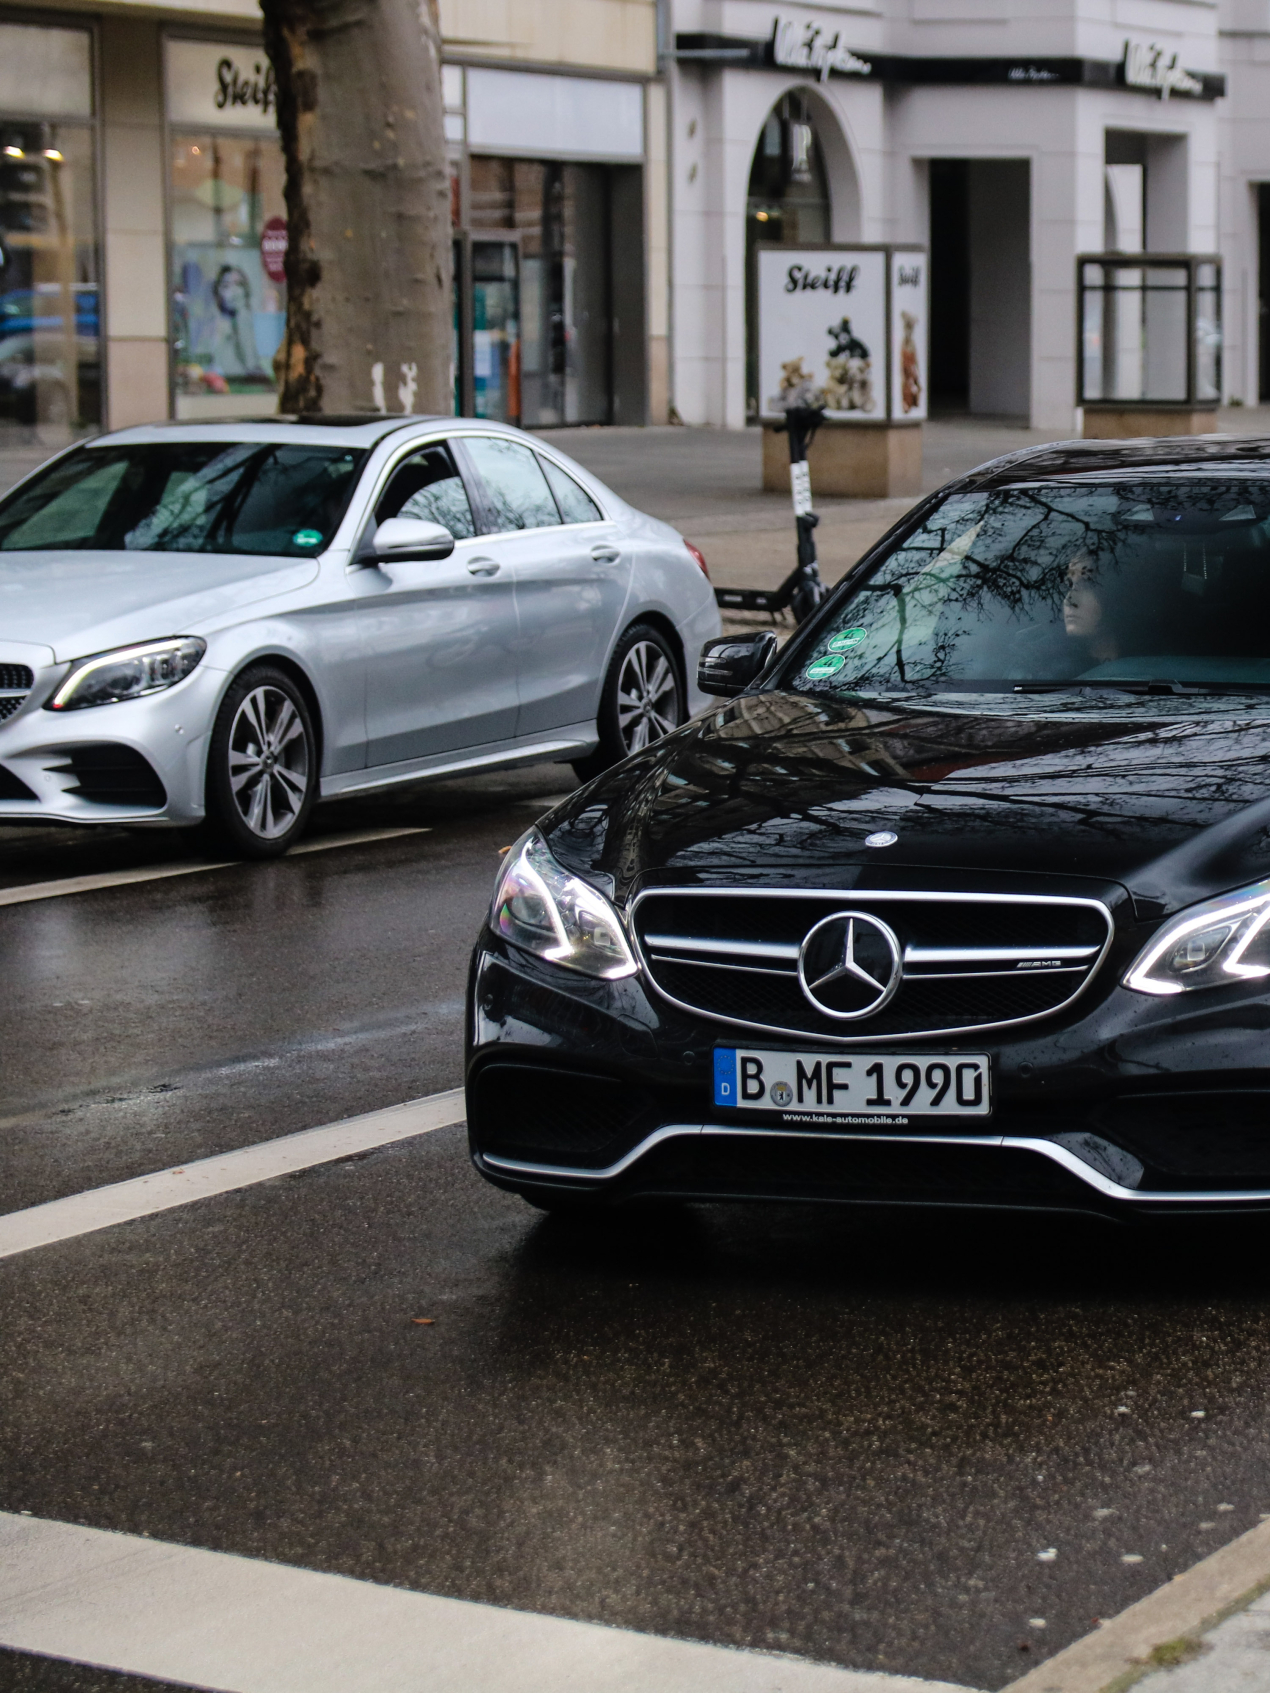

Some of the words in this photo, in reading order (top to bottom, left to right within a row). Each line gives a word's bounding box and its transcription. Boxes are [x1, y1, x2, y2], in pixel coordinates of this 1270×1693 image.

[214, 57, 278, 114] Steif
[785, 263, 860, 294] Steiff
[1031, 960, 1062, 968] AMG
[721, 1082, 730, 1095] D
[740, 1055, 766, 1100] B
[796, 1058, 853, 1104] MF
[865, 1061, 983, 1106] 1990
[782, 1112, 909, 1124] www.kale-automobile.de
